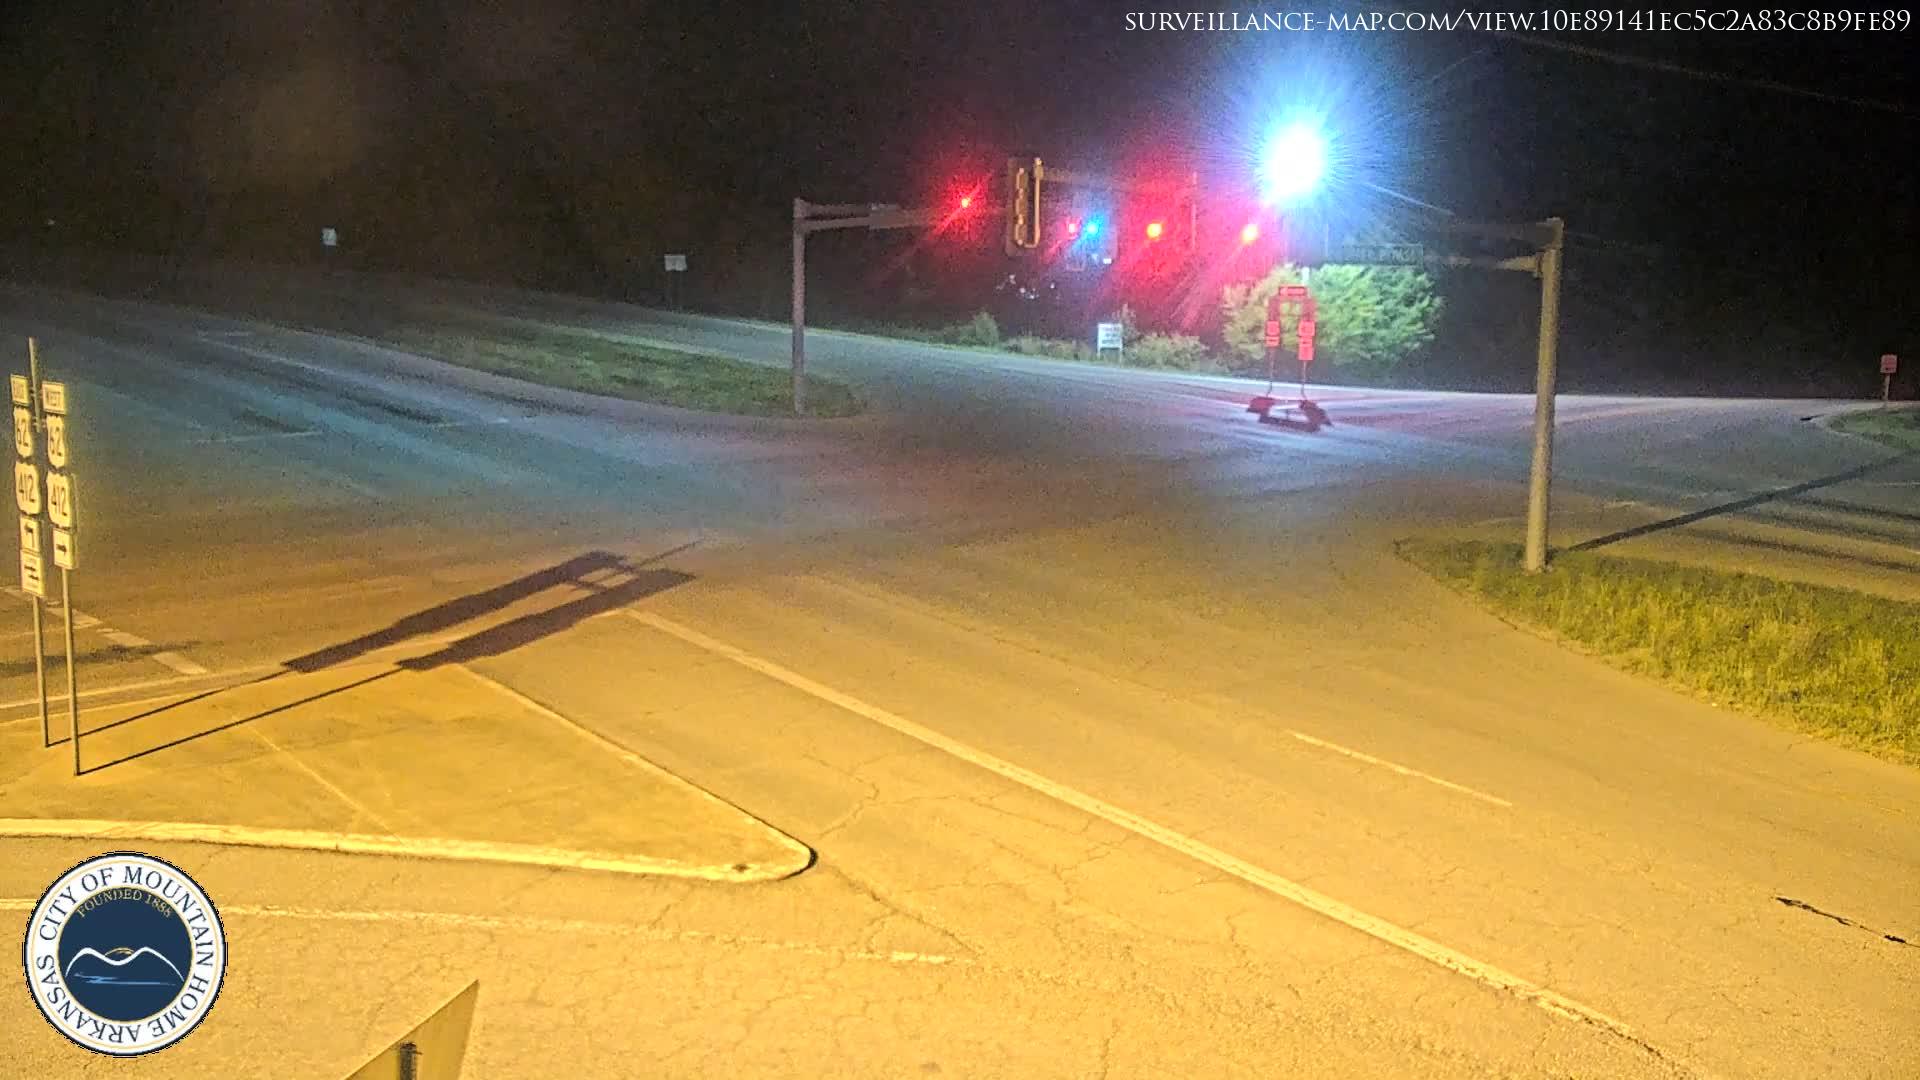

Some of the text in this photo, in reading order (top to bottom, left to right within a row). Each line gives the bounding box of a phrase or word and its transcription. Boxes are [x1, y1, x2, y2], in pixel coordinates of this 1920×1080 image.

[16, 418, 29, 447] 62
[50, 426, 63, 457] 62
[18, 472, 35, 503] 412
[51, 484, 68, 516] 412
